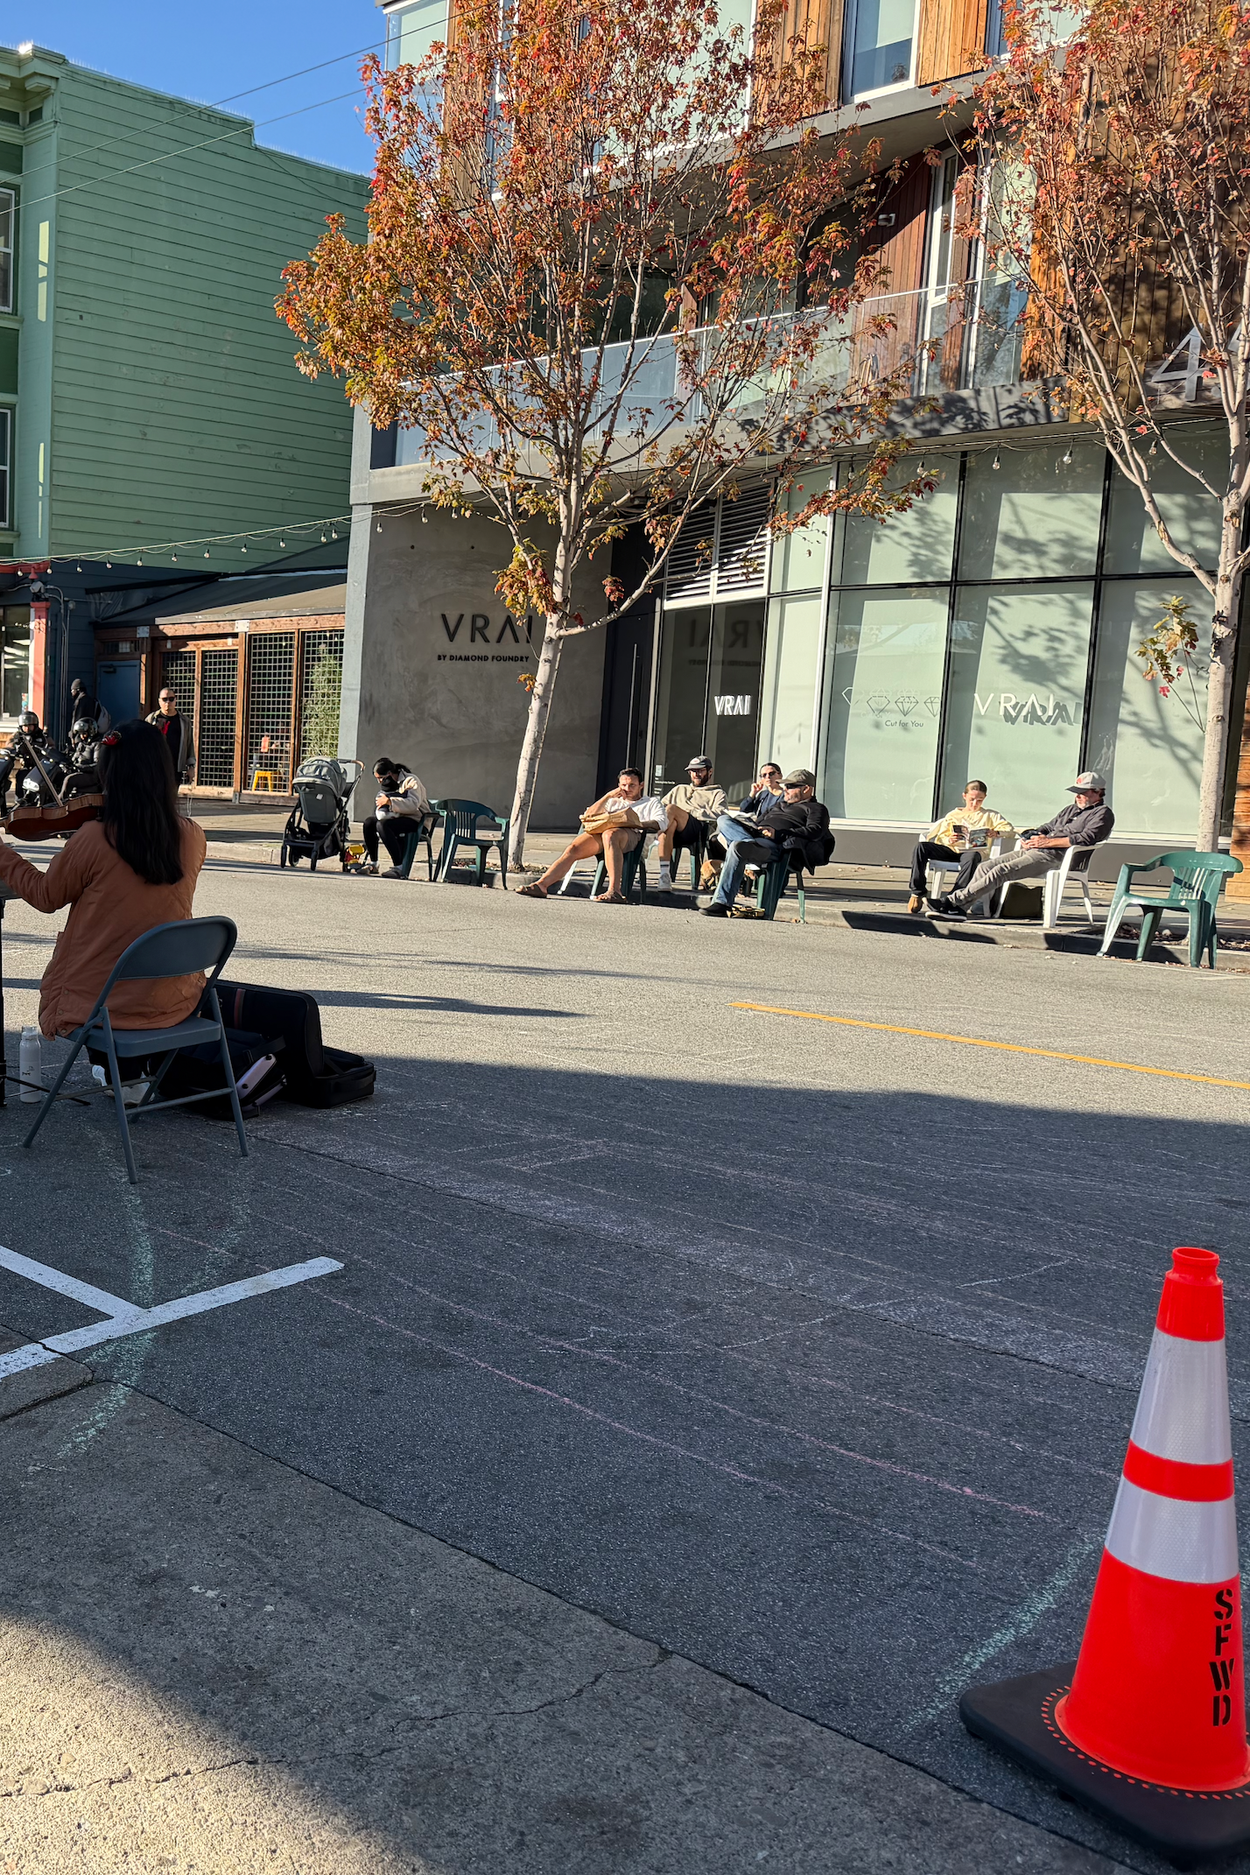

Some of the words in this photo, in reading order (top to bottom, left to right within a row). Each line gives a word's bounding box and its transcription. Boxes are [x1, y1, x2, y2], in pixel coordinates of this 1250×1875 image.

[440, 613, 533, 644] VRAI
[449, 654, 489, 662] DIAMOND
[491, 655, 530, 663] FOUNDRY
[714, 695, 751, 716] VRAI
[973, 693, 1054, 716] VRAI
[884, 719, 898, 727] Cut
[898, 719, 909, 728] for
[910, 720, 924, 728] You
[1209, 1588, 1235, 1727] SFWD
